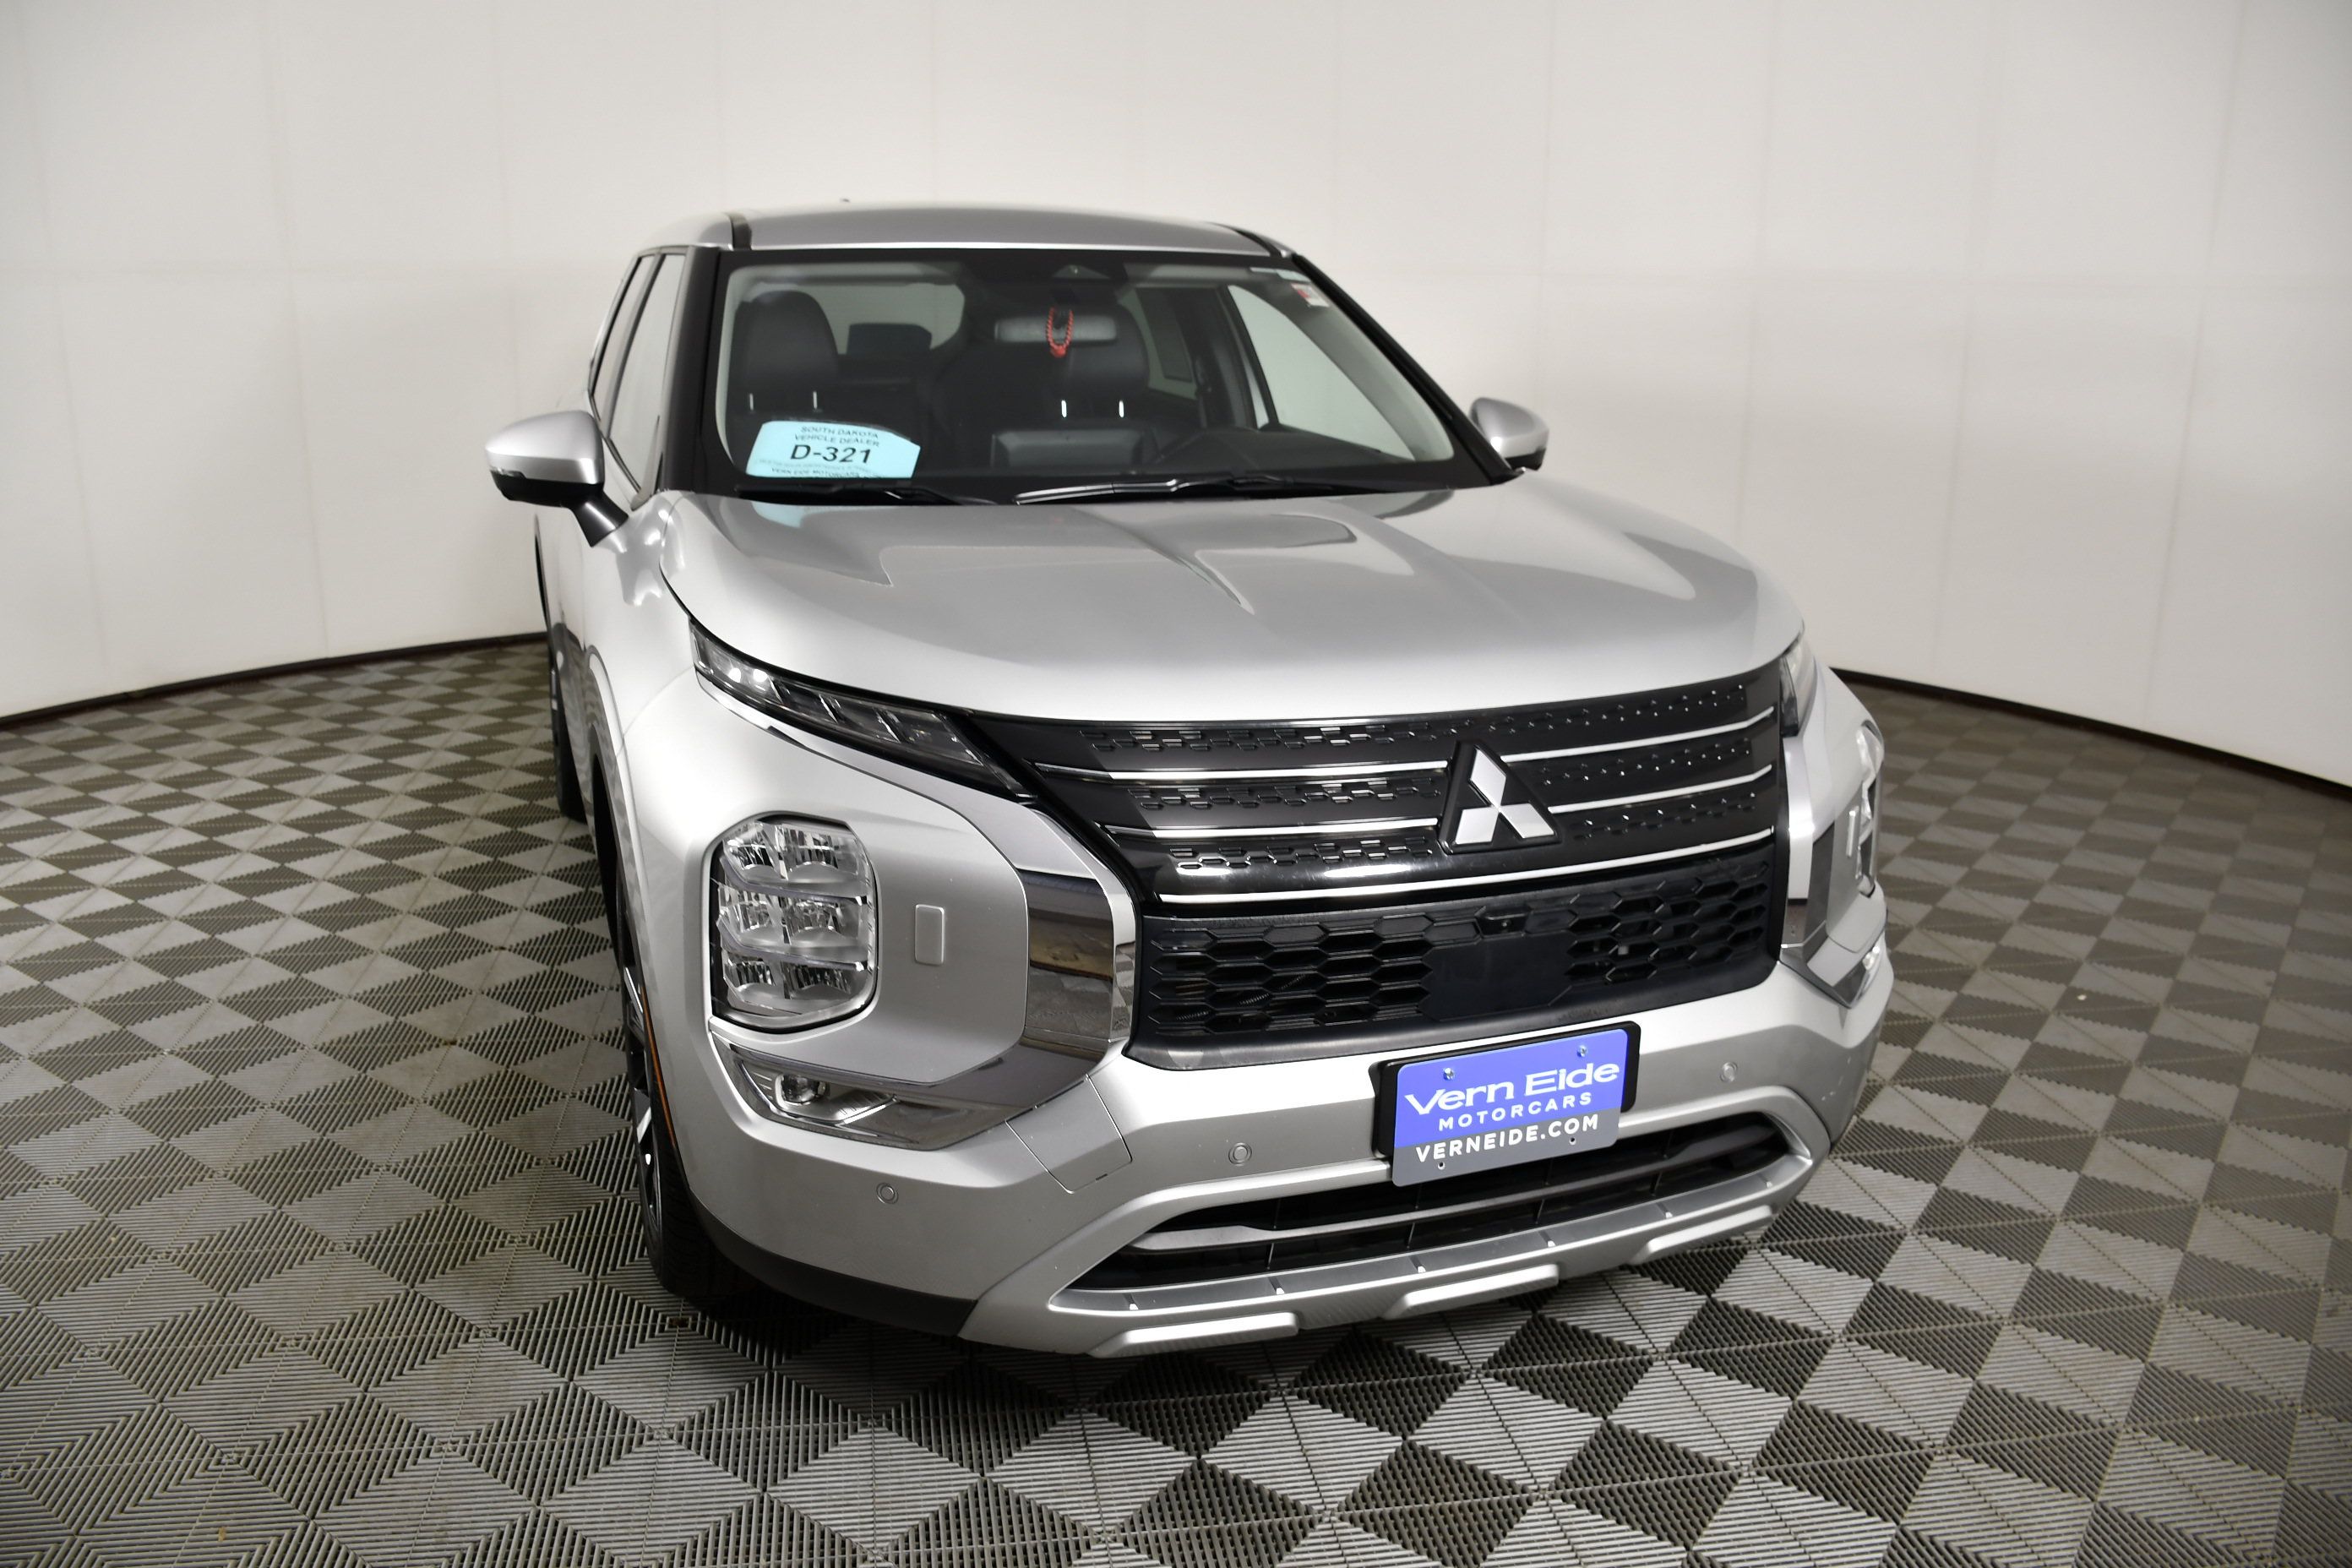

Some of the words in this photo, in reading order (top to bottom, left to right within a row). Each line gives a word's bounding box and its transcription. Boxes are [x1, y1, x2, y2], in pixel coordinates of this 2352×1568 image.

[795, 434, 836, 444] VEHICLE
[840, 437, 879, 447] DEALER
[801, 426, 835, 435] SOUTH
[838, 429, 879, 438] DAKOTA
[791, 444, 871, 464] D-321
[1405, 1081, 1514, 1115] Vern
[1524, 1063, 1620, 1097] Eide
[1439, 1092, 1592, 1132] MOTORCARS
[1416, 1113, 1598, 1162] VERNEIDE.COM
